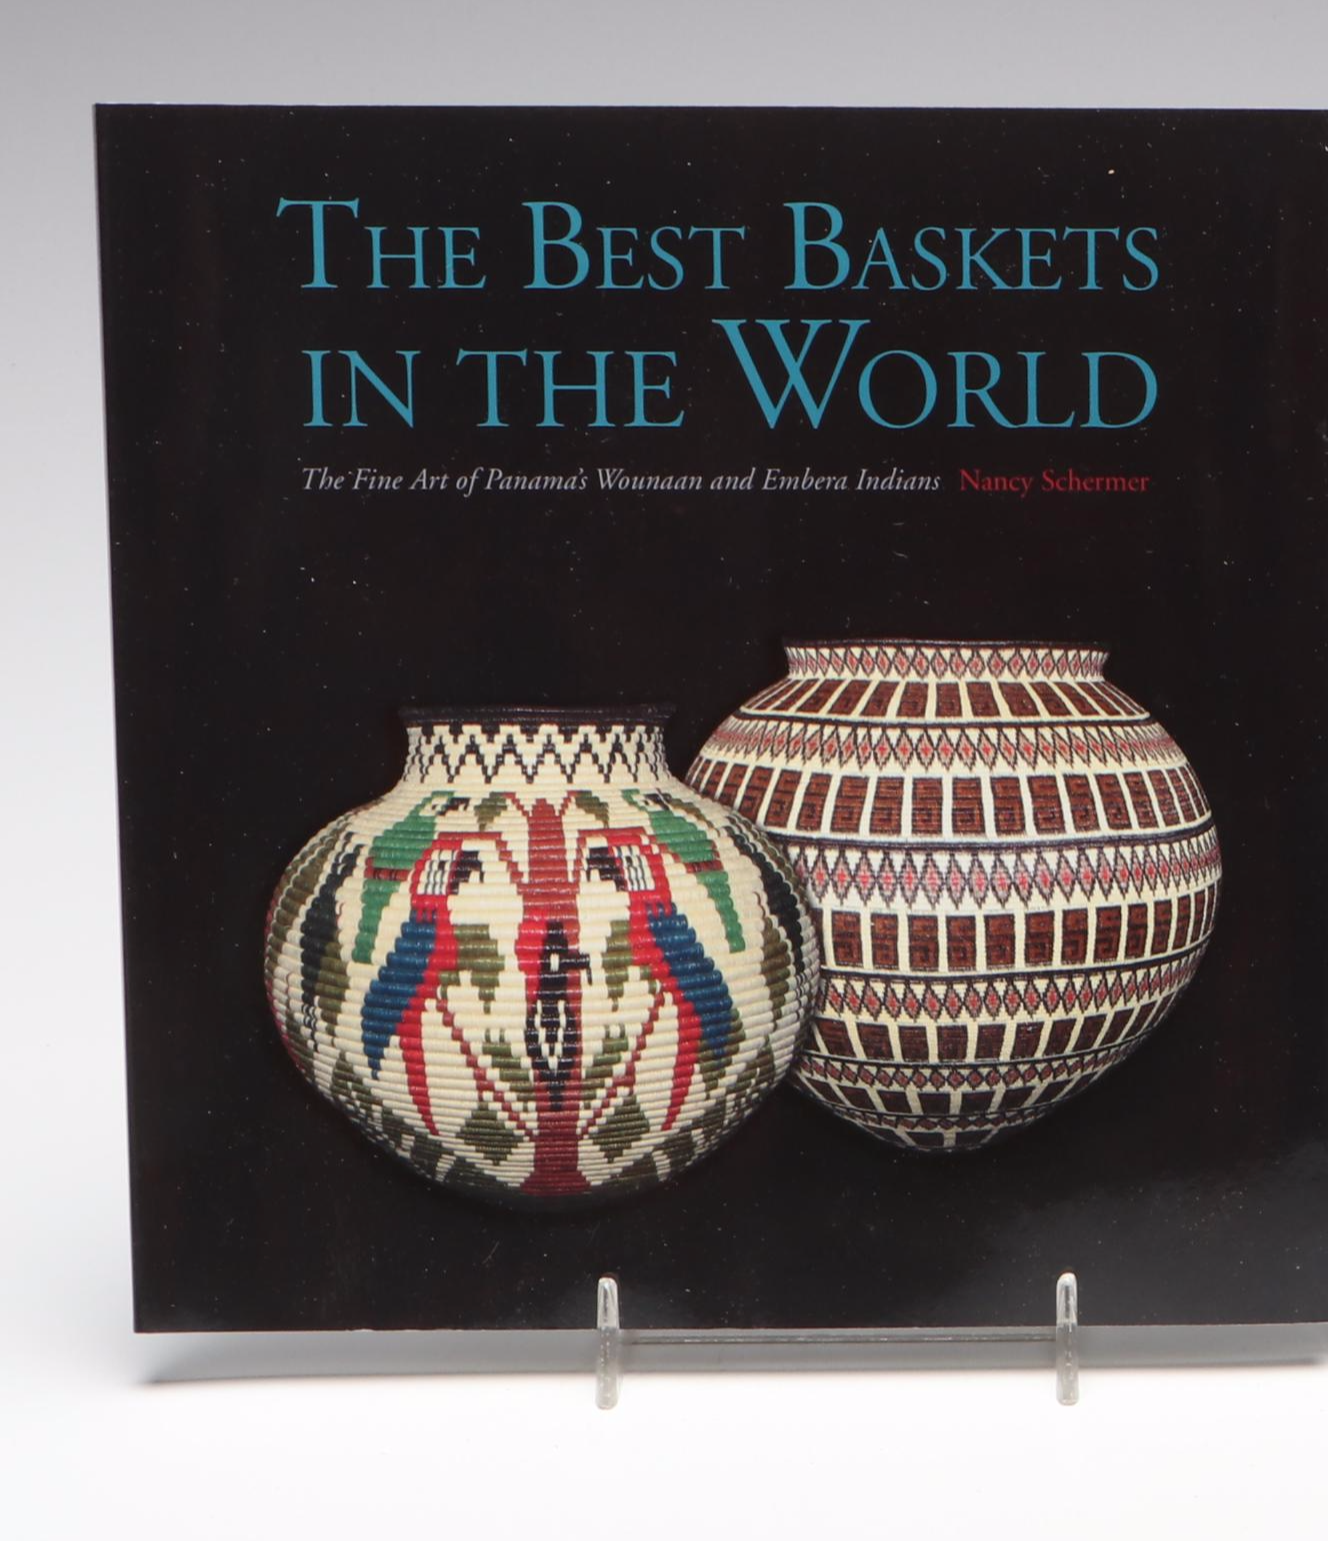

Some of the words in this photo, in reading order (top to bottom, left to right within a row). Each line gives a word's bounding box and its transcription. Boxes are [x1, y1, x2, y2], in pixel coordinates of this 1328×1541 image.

[302, 466, 345, 490] The
[352, 467, 404, 490] Fine
[409, 468, 449, 490] Art
[456, 466, 484, 498] of
[484, 466, 588, 490] Panama's
[598, 467, 703, 490] Wounaan
[710, 466, 756, 490] and
[762, 466, 848, 491] Embera
[856, 466, 941, 491] Indians
[959, 468, 1033, 498] Nancy
[1041, 467, 1151, 492] Schermer
